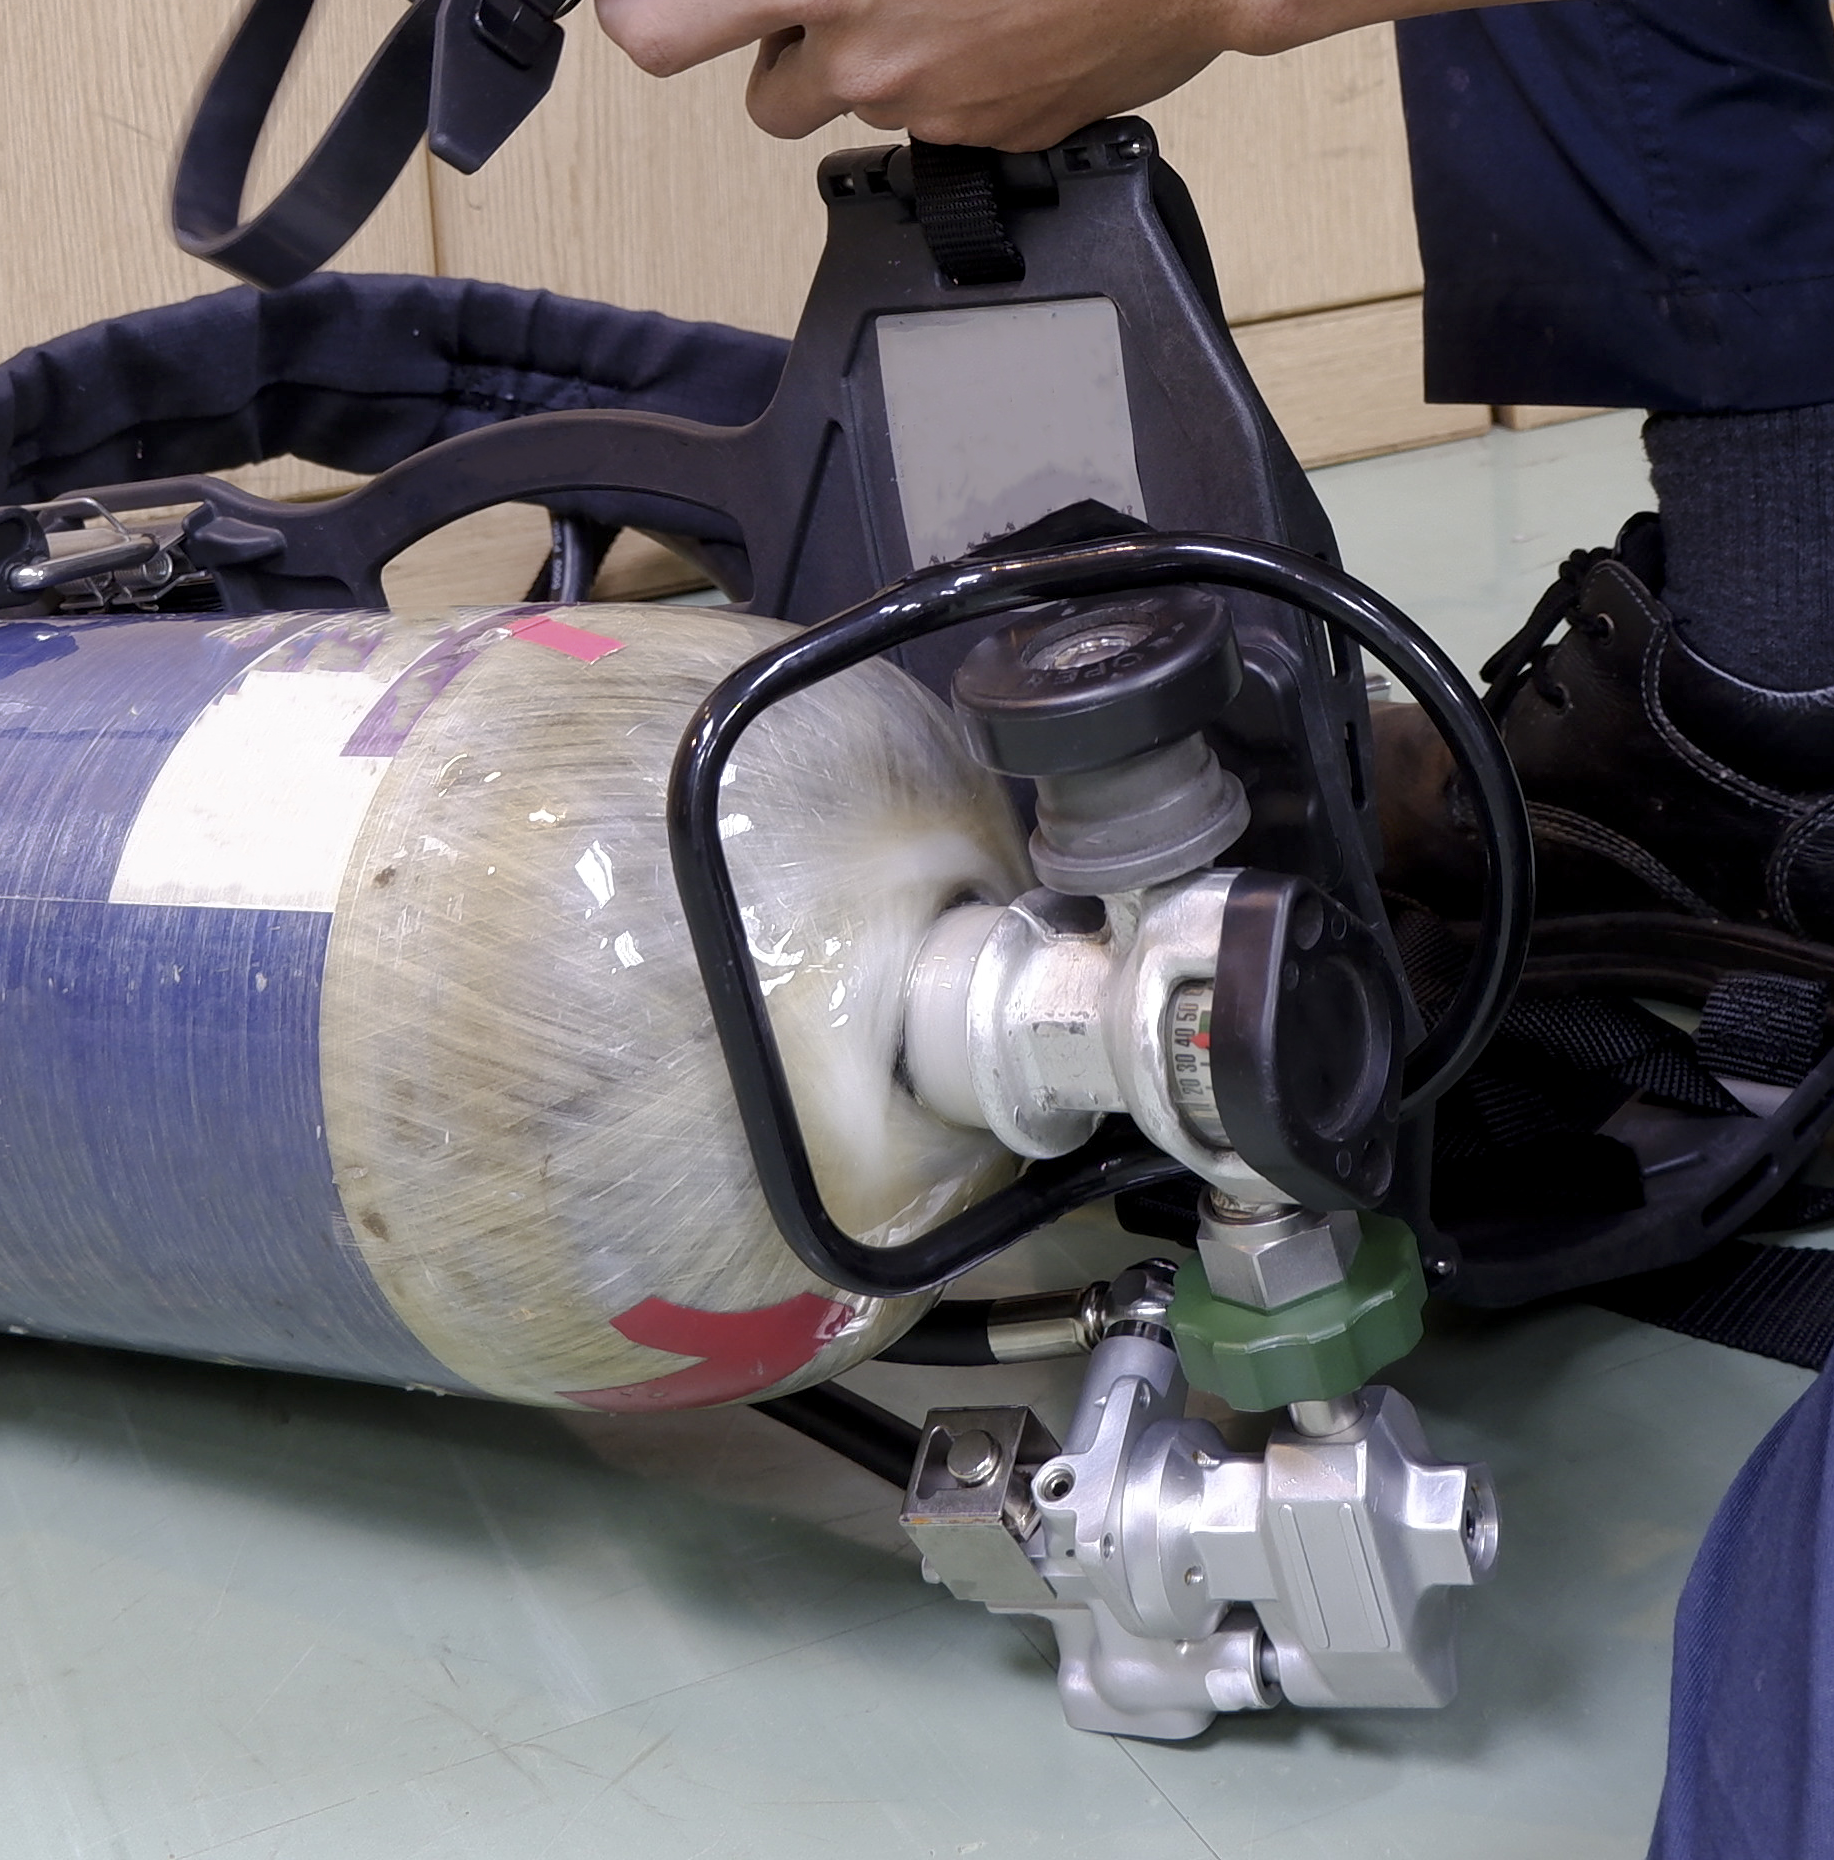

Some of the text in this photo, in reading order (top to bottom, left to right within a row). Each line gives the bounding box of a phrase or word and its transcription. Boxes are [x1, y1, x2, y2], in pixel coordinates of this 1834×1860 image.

[1176, 1003, 1198, 1021] 50
[1174, 1028, 1195, 1047] 40
[1175, 1054, 1197, 1072] 30
[1179, 1078, 1203, 1095] 20
